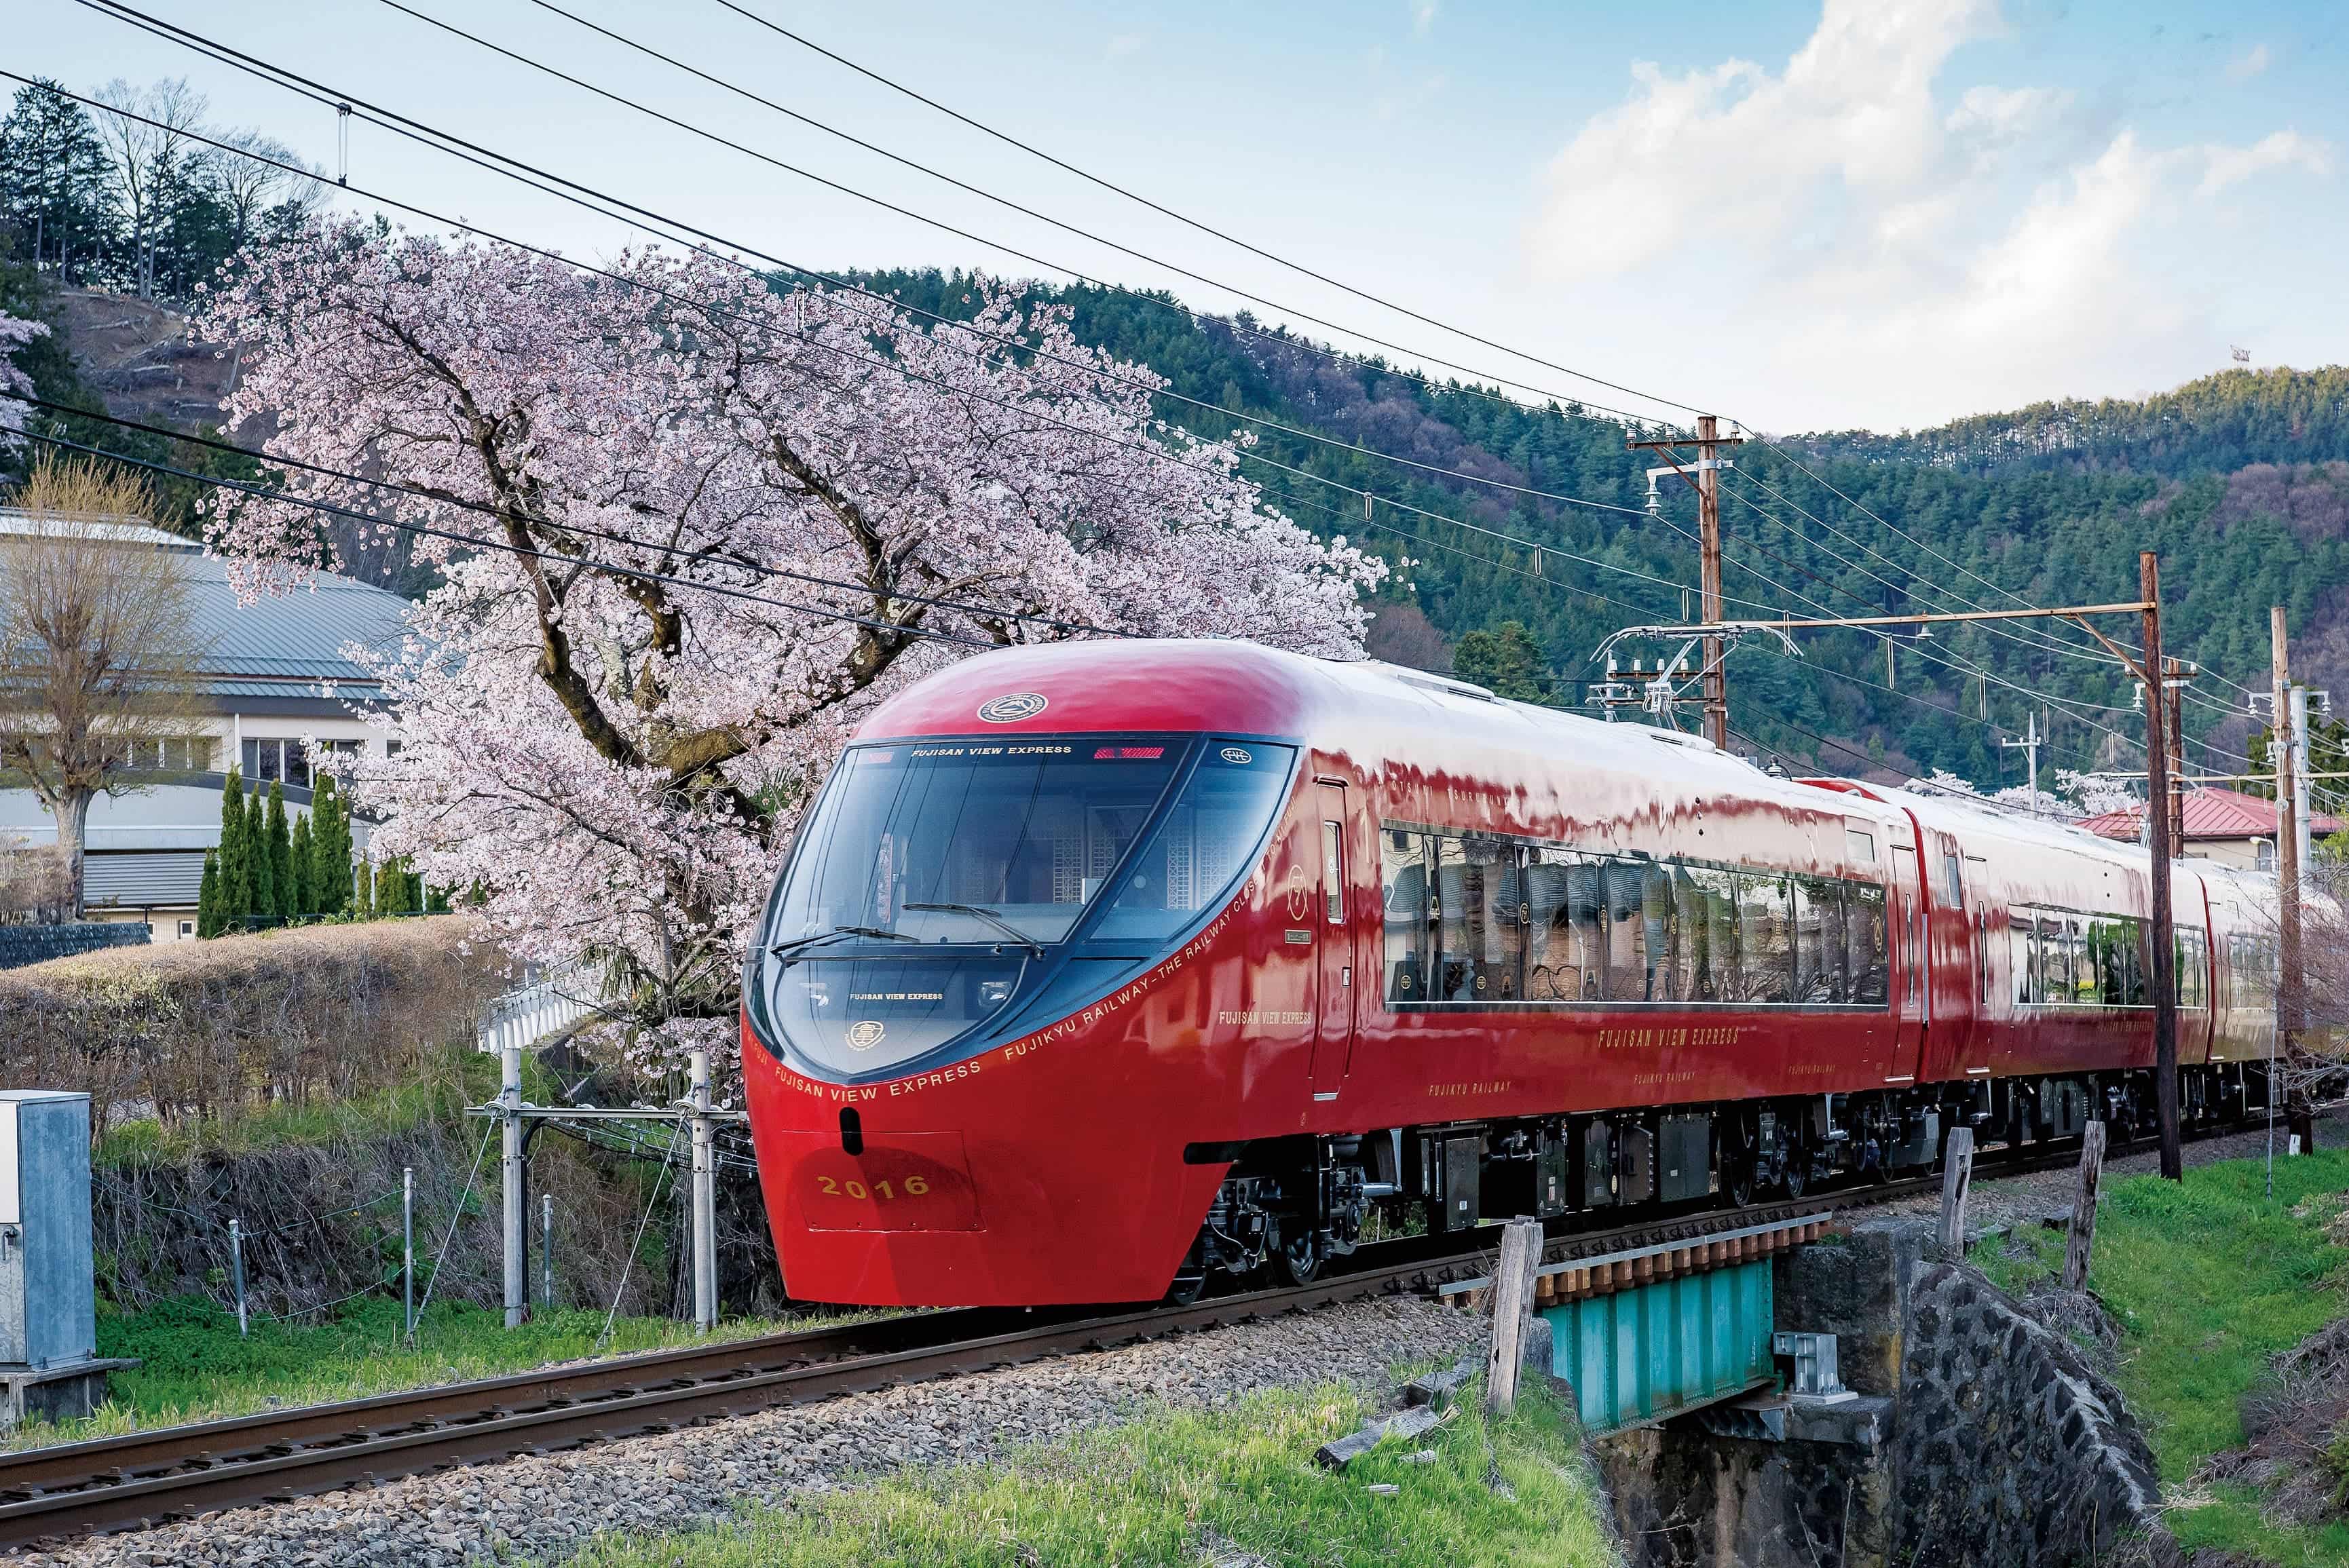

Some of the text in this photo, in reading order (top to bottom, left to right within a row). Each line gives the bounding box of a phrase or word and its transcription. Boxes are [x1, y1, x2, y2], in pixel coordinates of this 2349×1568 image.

[911, 748, 964, 757] FUJISAN
[1004, 1020, 1076, 1060] FUJIKYU
[1185, 911, 1230, 959] RAILWAY
[1233, 859, 1266, 912] CLOST
[1218, 1011, 1311, 1025] FUJISAN VIEW EXPRESS
[1598, 1027, 1739, 1048] FUJISAN VIEW EXPRESS
[775, 1061, 981, 1102] FUJISAN VIEW EXPRESS
[1428, 1081, 1511, 1096] FUJIKYU RAILWAY
[817, 1176, 929, 1199] 2016
